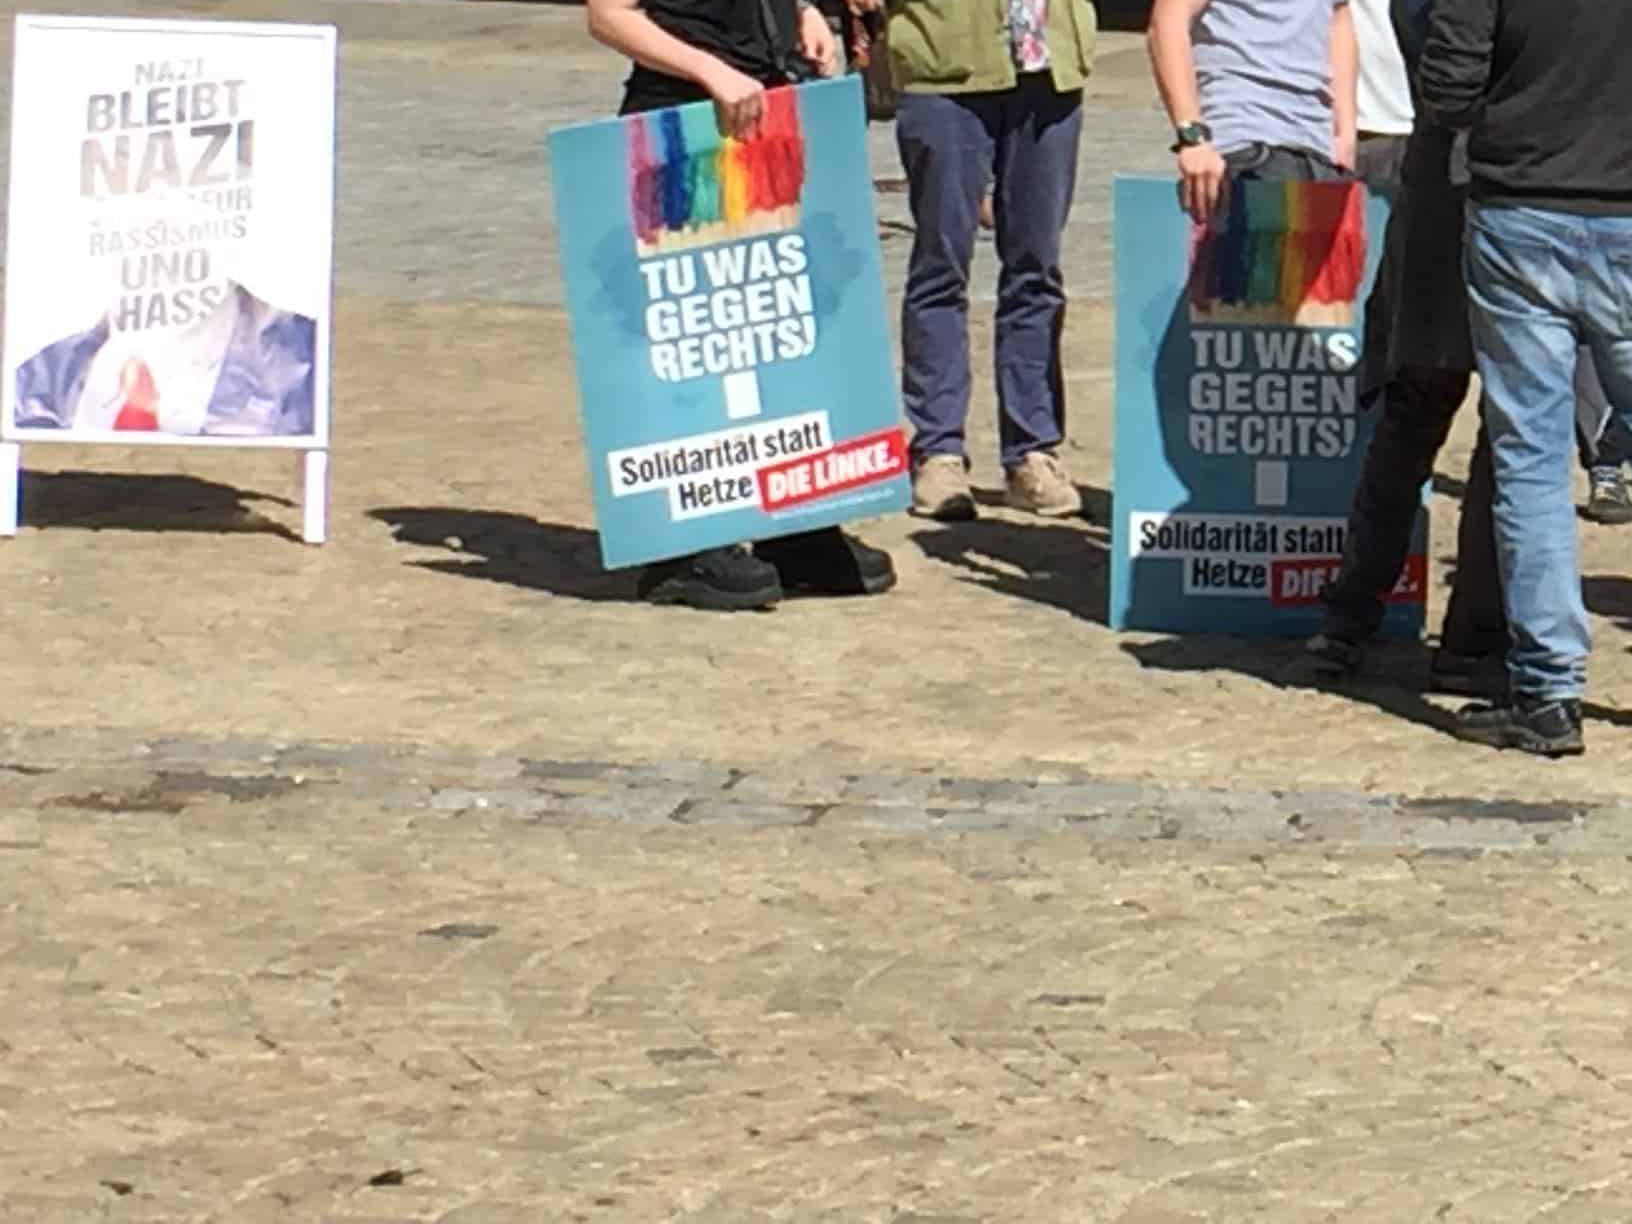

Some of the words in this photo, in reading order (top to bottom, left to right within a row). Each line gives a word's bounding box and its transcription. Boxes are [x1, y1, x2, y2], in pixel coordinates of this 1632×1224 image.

[134, 57, 205, 86] NAZI
[86, 79, 246, 134] BLEIBT
[79, 119, 256, 197] NAZI
[120, 248, 211, 290] UND
[641, 255, 697, 300] TU
[703, 233, 808, 287] WAS
[116, 283, 224, 333] HASS
[645, 274, 814, 343] GEGEN
[650, 315, 817, 383] RECHTS!
[1191, 330, 1244, 369] TU
[1253, 331, 1359, 372] WAS
[1189, 372, 1357, 414] GEGEN
[619, 427, 761, 486] Solidarität
[764, 422, 823, 458] statt
[1188, 413, 1357, 457] RECHTS!
[679, 473, 754, 513] Hetze
[766, 463, 812, 503] DIE
[1140, 520, 1278, 554] Solidarität
[1283, 525, 1344, 553] statt
[1191, 558, 1266, 588] Hetze
